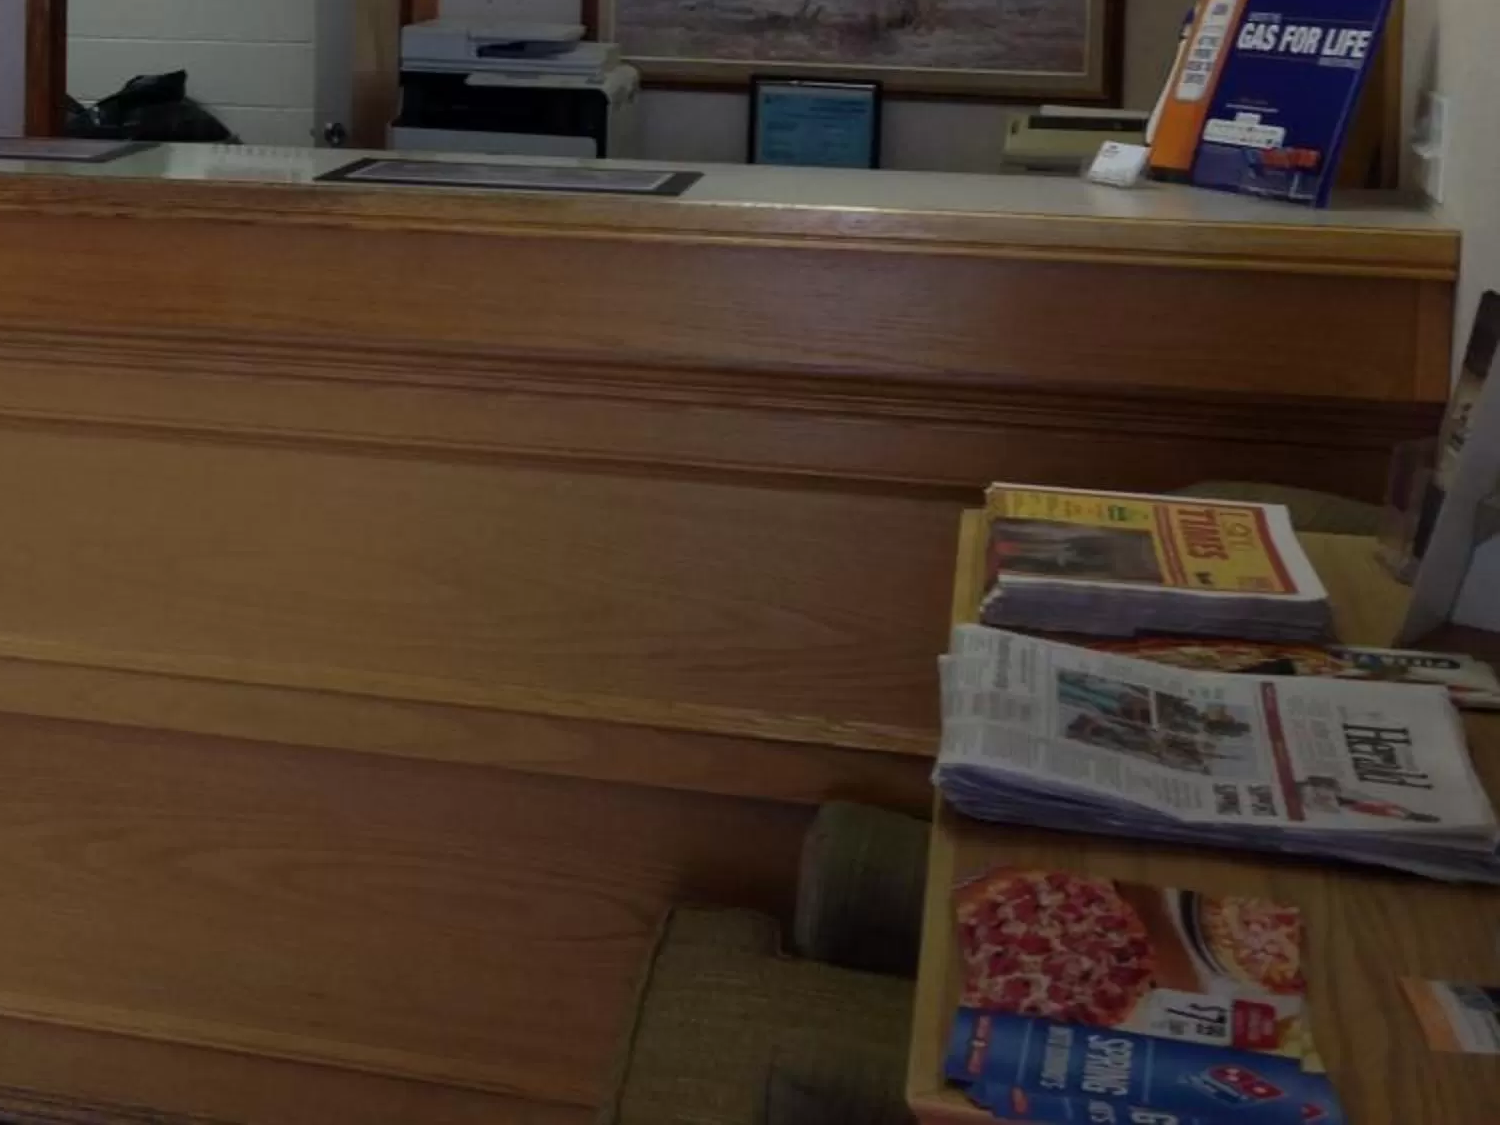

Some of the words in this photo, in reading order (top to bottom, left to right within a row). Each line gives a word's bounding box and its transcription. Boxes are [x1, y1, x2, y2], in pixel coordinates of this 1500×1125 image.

[1237, 22, 1280, 52] GAS
[1278, 25, 1323, 55] FOR
[1321, 28, 1373, 59] LIFE
[1342, 722, 1435, 792] Herald
[1080, 1034, 1136, 1097] SPRING
